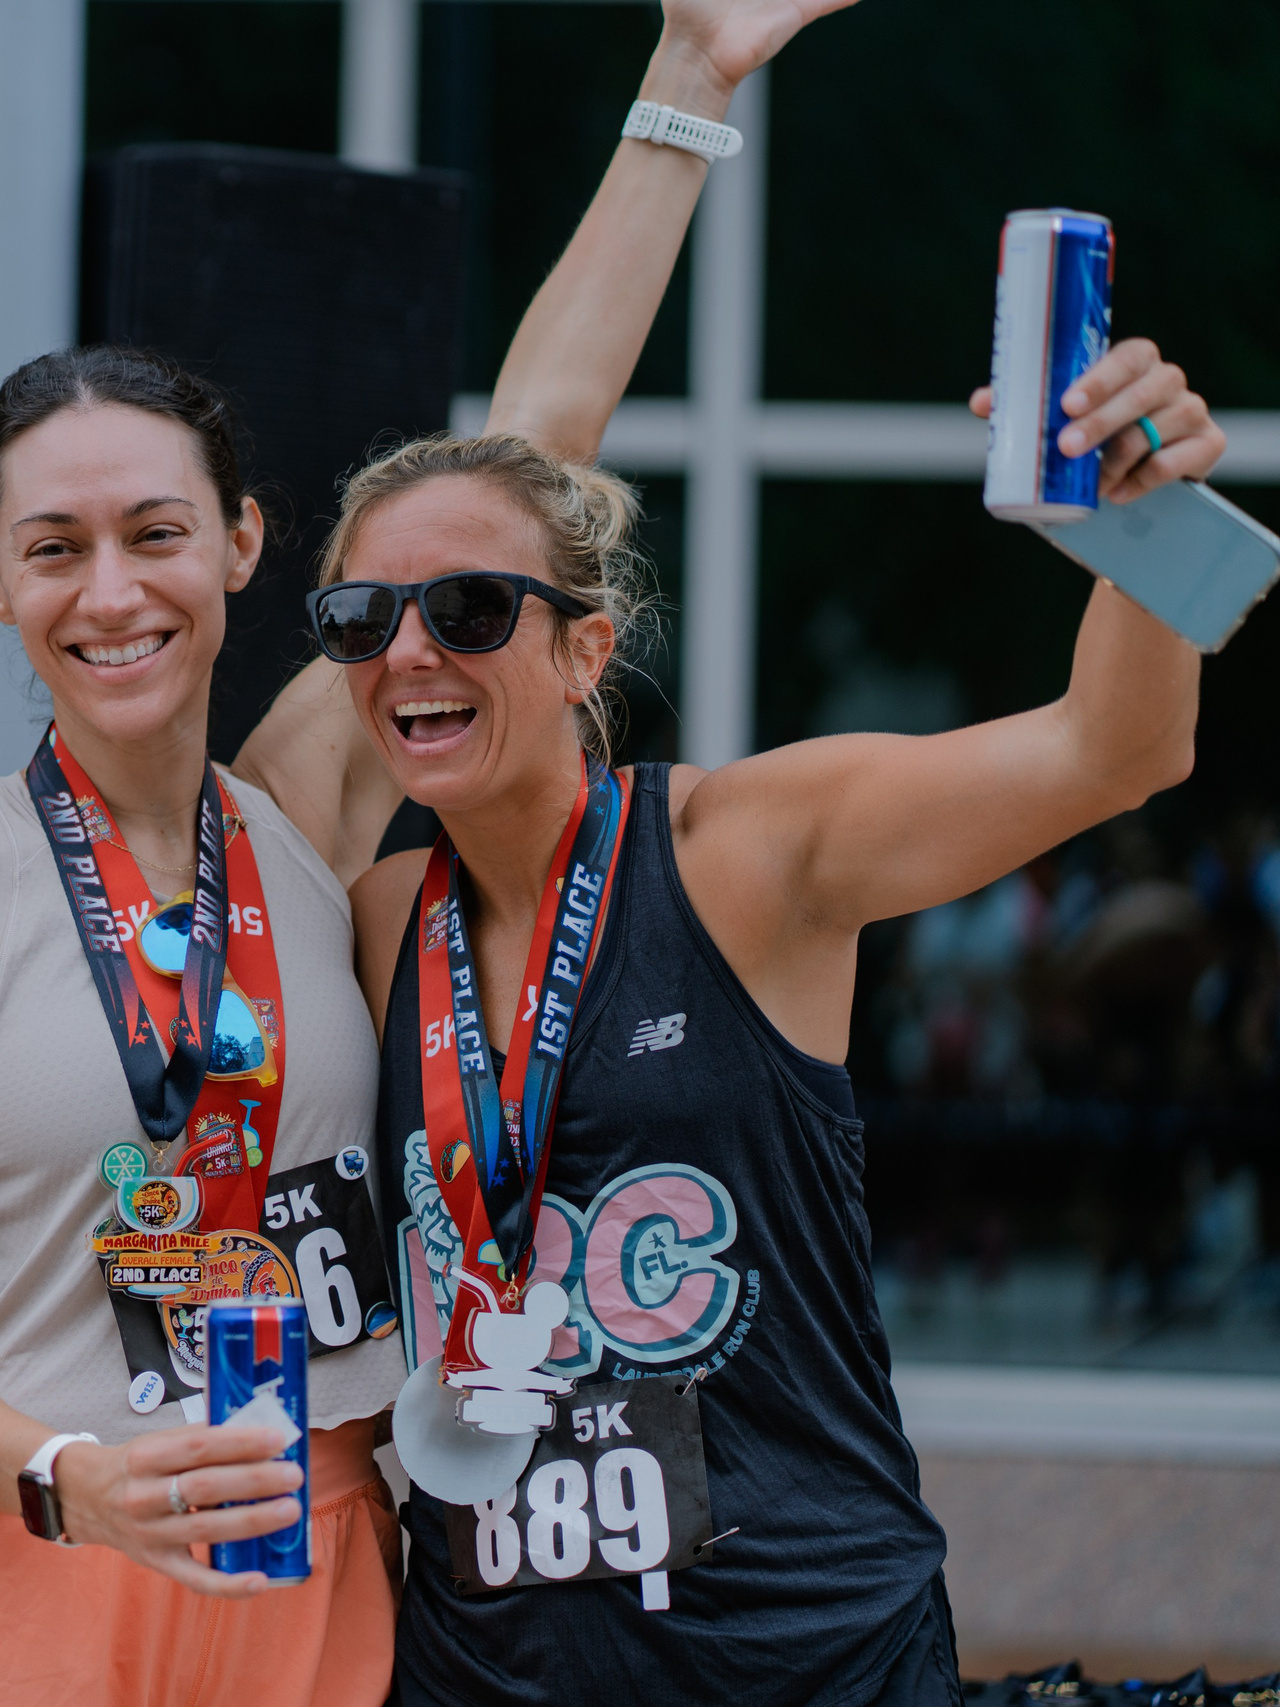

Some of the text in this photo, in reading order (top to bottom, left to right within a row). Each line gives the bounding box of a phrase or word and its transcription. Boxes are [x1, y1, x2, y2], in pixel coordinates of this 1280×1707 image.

[39, 791, 87, 844] 2ND
[191, 798, 223, 953] 2ND PLACE
[60, 854, 124, 953] PLACE
[538, 862, 604, 1059] 1ST PLACE
[448, 898, 486, 1074] 1ST PLACE
[626, 1012, 687, 1058] NB
[144, 1205, 160, 1218] 5K
[264, 1183, 323, 1230] 5K
[103, 1233, 210, 1253] MARGARITA MILE
[121, 1256, 193, 1265] OVERALL FEMALE
[112, 1267, 200, 1283] 2ND PLACE
[722, 1318, 752, 1358] RUN
[741, 1268, 761, 1318] CLUB
[571, 1401, 633, 1443] 5K
[473, 1447, 670, 1587] 889
